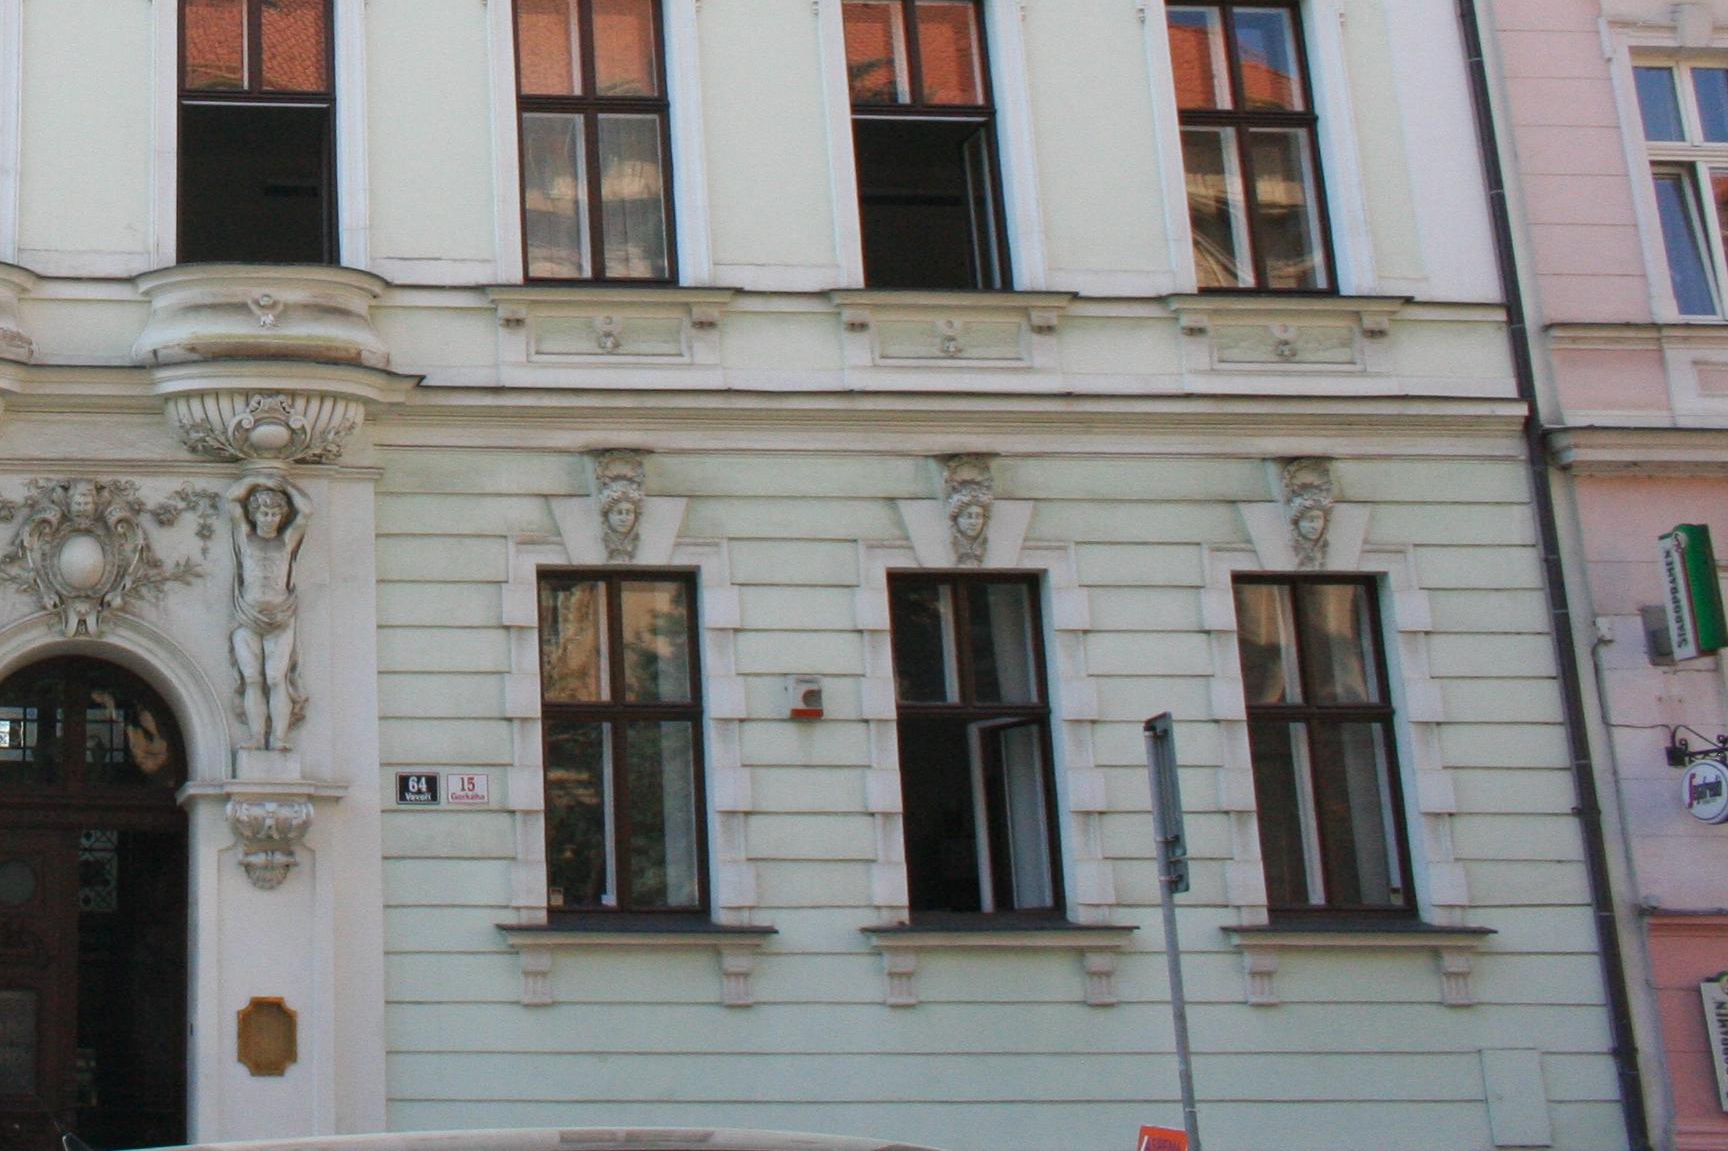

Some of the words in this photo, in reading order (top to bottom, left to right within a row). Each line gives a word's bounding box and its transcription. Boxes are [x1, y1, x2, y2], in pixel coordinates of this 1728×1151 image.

[1664, 549, 1688, 648] STAROPRAMEN
[409, 776, 427, 792] 64
[460, 776, 475, 792] 15
